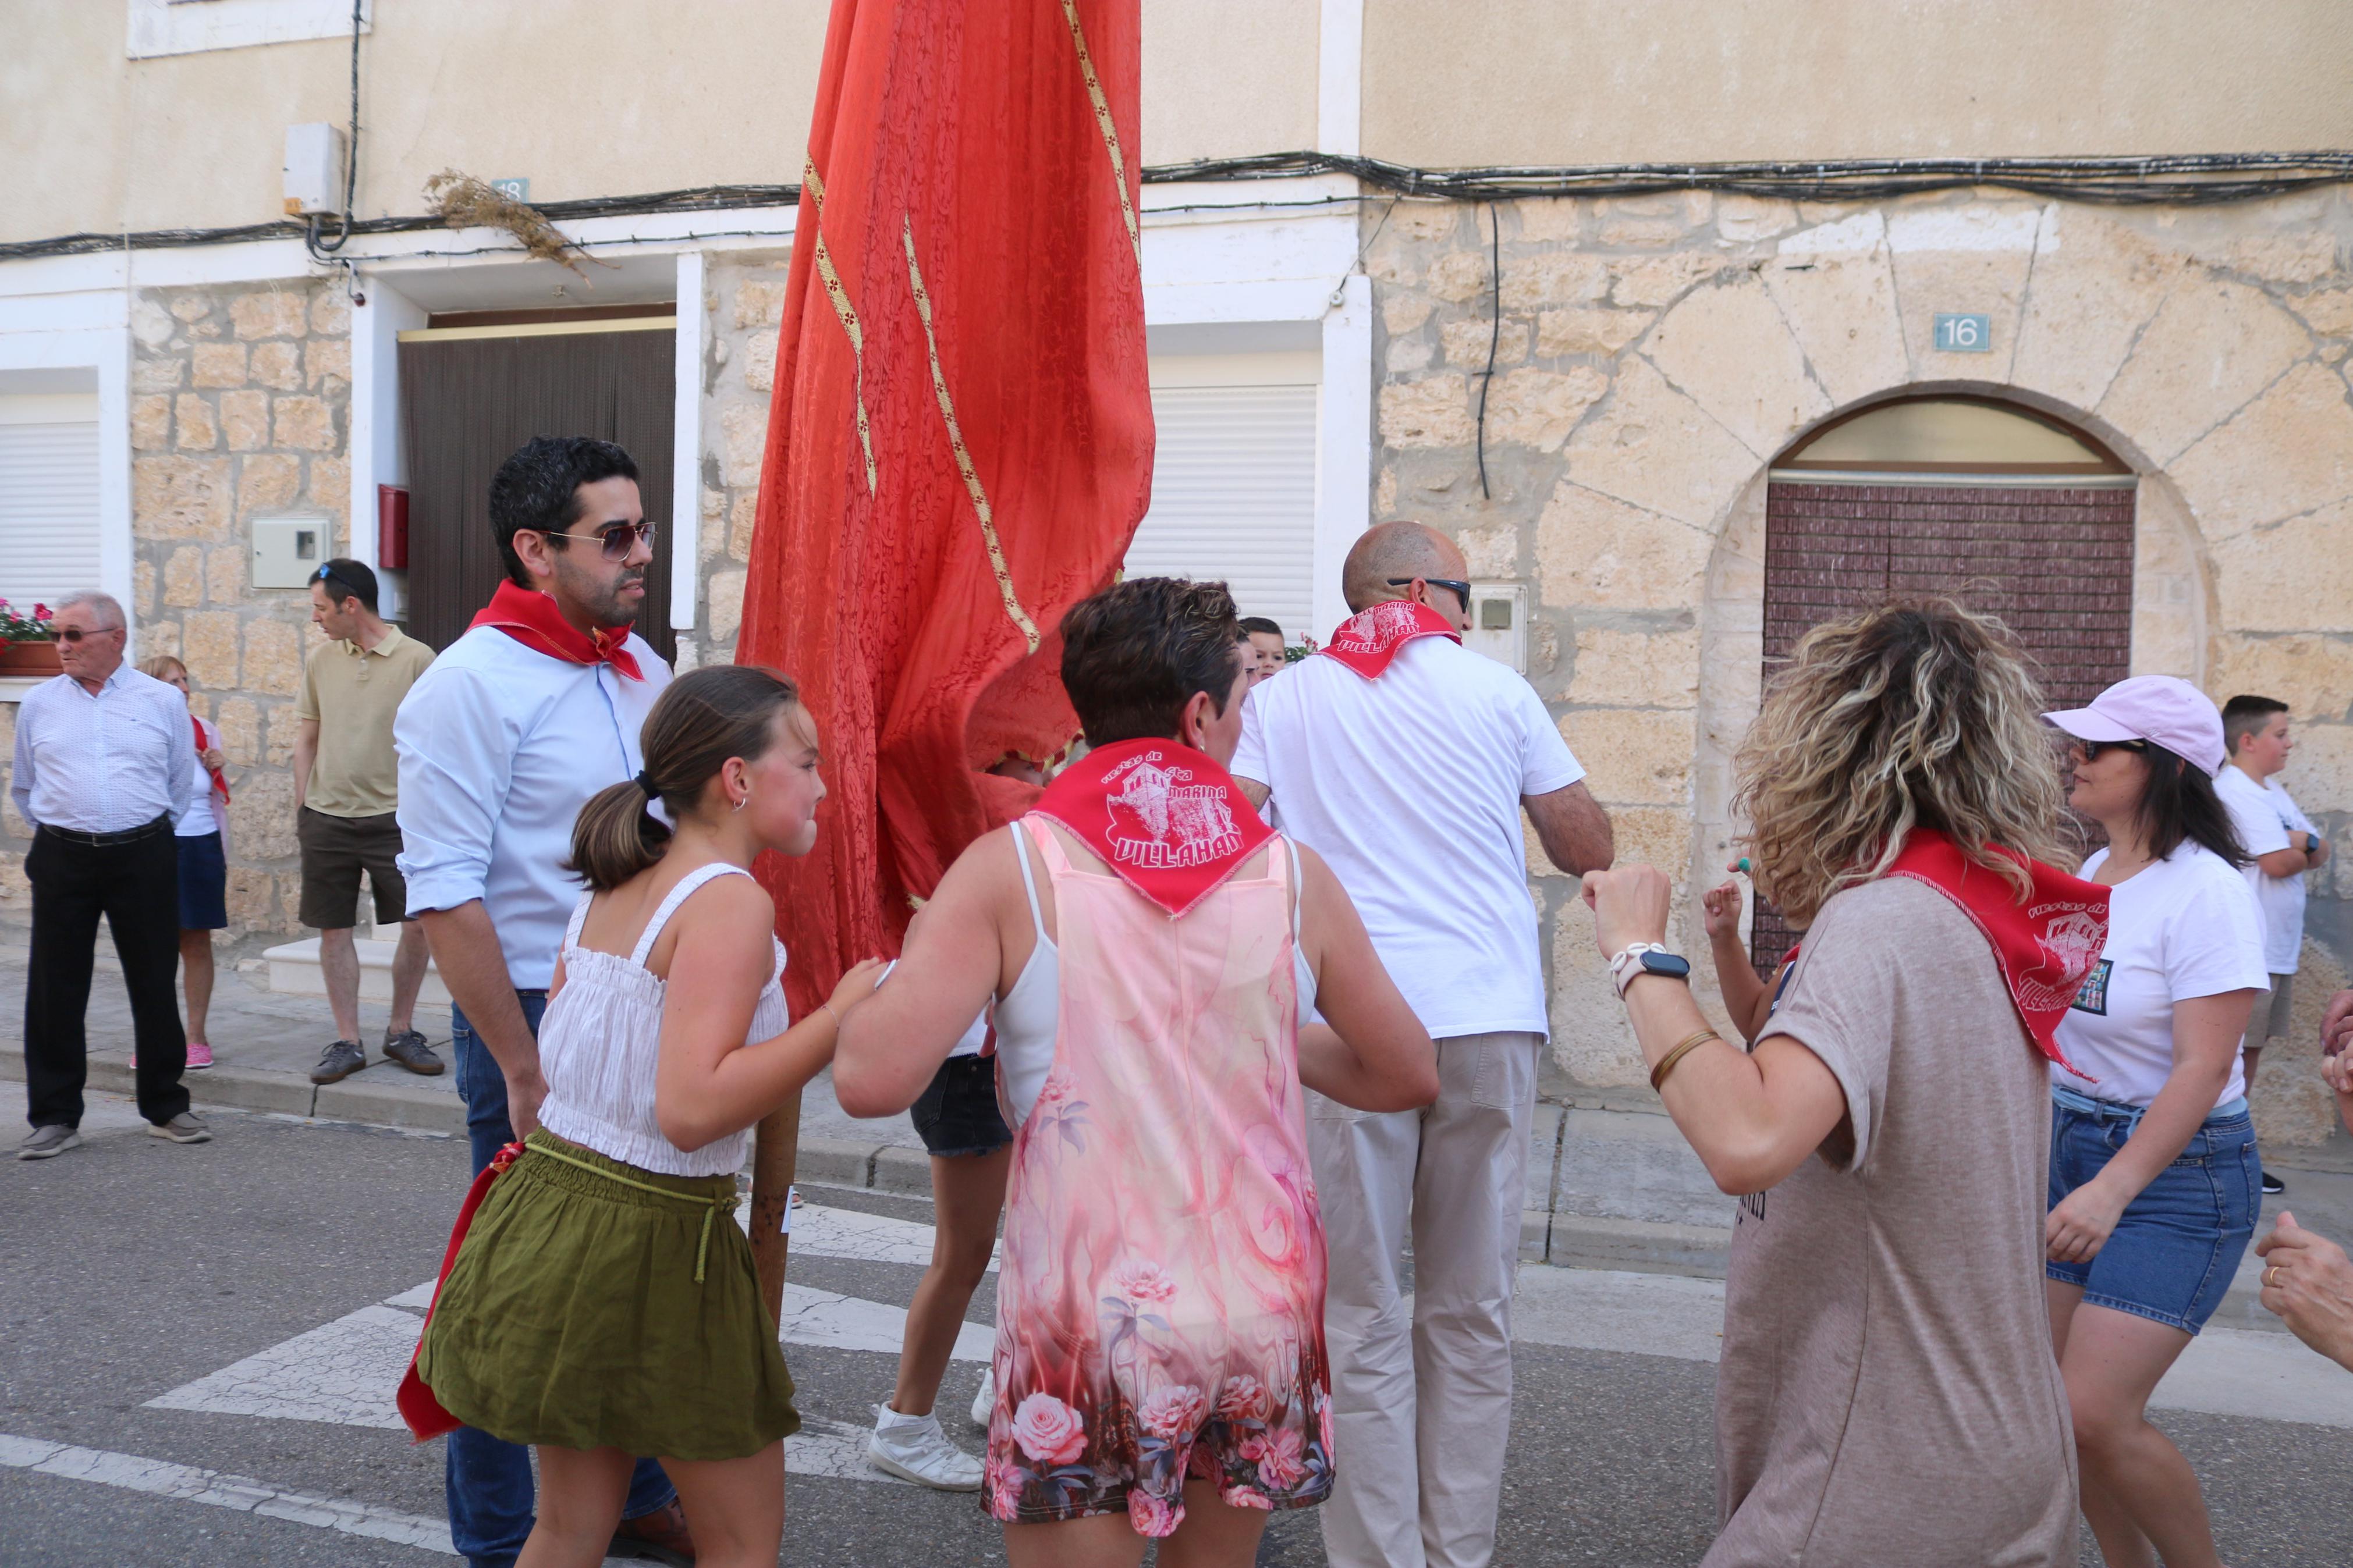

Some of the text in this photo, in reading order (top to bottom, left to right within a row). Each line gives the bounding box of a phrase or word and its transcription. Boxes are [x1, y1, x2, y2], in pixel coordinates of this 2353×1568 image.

[1944, 318, 1978, 346] 16
[1373, 602, 1415, 616] MARINA
[1167, 785, 1227, 799] MARINA
[1114, 832, 1244, 868] VILLAHAN
